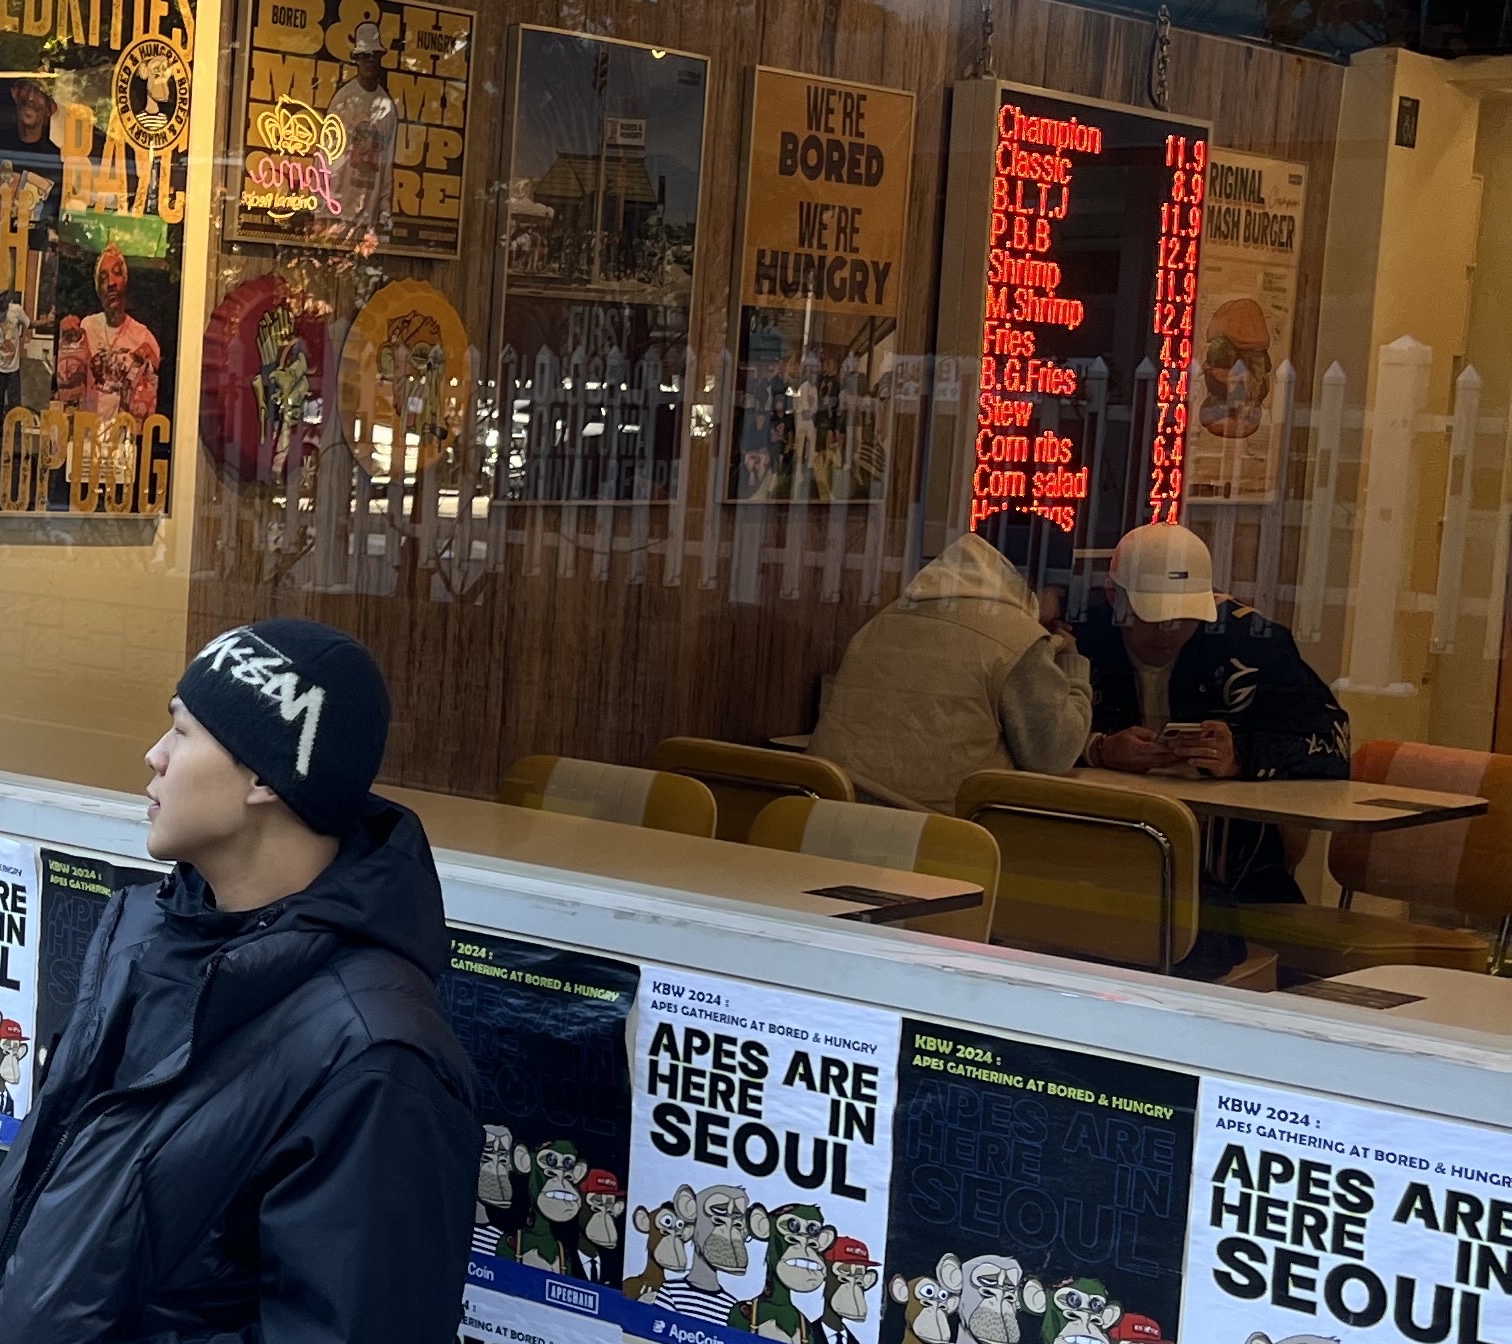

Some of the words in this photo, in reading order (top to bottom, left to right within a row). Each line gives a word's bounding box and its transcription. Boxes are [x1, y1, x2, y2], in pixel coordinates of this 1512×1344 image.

[271, 4, 307, 30] BORED
[117, 68, 131, 115] BORED
[177, 76, 189, 126] BORED
[61, 102, 189, 224] BAYC
[778, 131, 884, 187] BORED
[998, 104, 1102, 156] Champion
[1165, 134, 1206, 172] 11.9
[995, 141, 1073, 184] Classic
[1171, 170, 1204, 204] 8.9
[1208, 161, 1266, 204] RIGINAL
[992, 176, 1070, 220] B.L.T.J
[1160, 202, 1202, 237] 11.9
[1206, 205, 1240, 242] MASH
[1243, 209, 1296, 253] BURGER
[990, 212, 1051, 253] P.B.B
[1158, 236, 1197, 270] 12.4
[754, 249, 892, 306] HUNGRY
[988, 248, 1062, 291] Shrimp
[1156, 269, 1196, 304] 11.9
[986, 284, 1084, 330] M.Shrimp
[1154, 303, 1193, 336] 12.4
[983, 320, 1036, 356] Fries
[1160, 337, 1192, 369] 4.9
[980, 356, 1077, 396] B.G.Fries
[1157, 369, 1188, 401] 6.4
[978, 392, 1033, 427] Stew
[1157, 403, 1186, 434] 7.9
[1034, 431, 1073, 463] ribs
[1153, 436, 1183, 466] 6.4
[1031, 466, 1088, 498] salad
[1151, 469, 1181, 499] 2.9
[652, 981, 685, 997] KBW
[651, 1000, 677, 1013] APES
[681, 1005, 747, 1027] GATHERING
[750, 1020, 765, 1031] AT
[768, 1023, 808, 1040] BORED
[812, 1032, 821, 1043] &
[824, 1035, 877, 1054] HUNGRY
[915, 1035, 952, 1055] KBW
[648, 1022, 768, 1079] APES
[782, 1050, 878, 1104] ARE
[913, 1057, 943, 1071] APES
[947, 1063, 1023, 1088] GATHERING
[1026, 1081, 1043, 1092] AT
[1047, 1084, 1093, 1103] BORED
[1097, 1095, 1107, 1107] &
[1111, 1098, 1172, 1120] HUNGRY
[647, 1058, 763, 1119] HERE
[828, 1098, 875, 1145] IN
[1217, 1096, 1261, 1116] KBW
[650, 1102, 866, 1201] SEOUL
[1215, 1118, 1251, 1134] APES
[1255, 1125, 1345, 1153] GATHERING
[1348, 1145, 1369, 1158] AT
[1374, 1149, 1428, 1170] BORED
[1434, 1162, 1445, 1174] &
[1450, 1165, 1512, 1189] HUNGR
[1211, 1143, 1374, 1214] APES
[1393, 1182, 1512, 1248] ARE
[1209, 1185, 1366, 1260] HERE
[1455, 1239, 1512, 1296] IN
